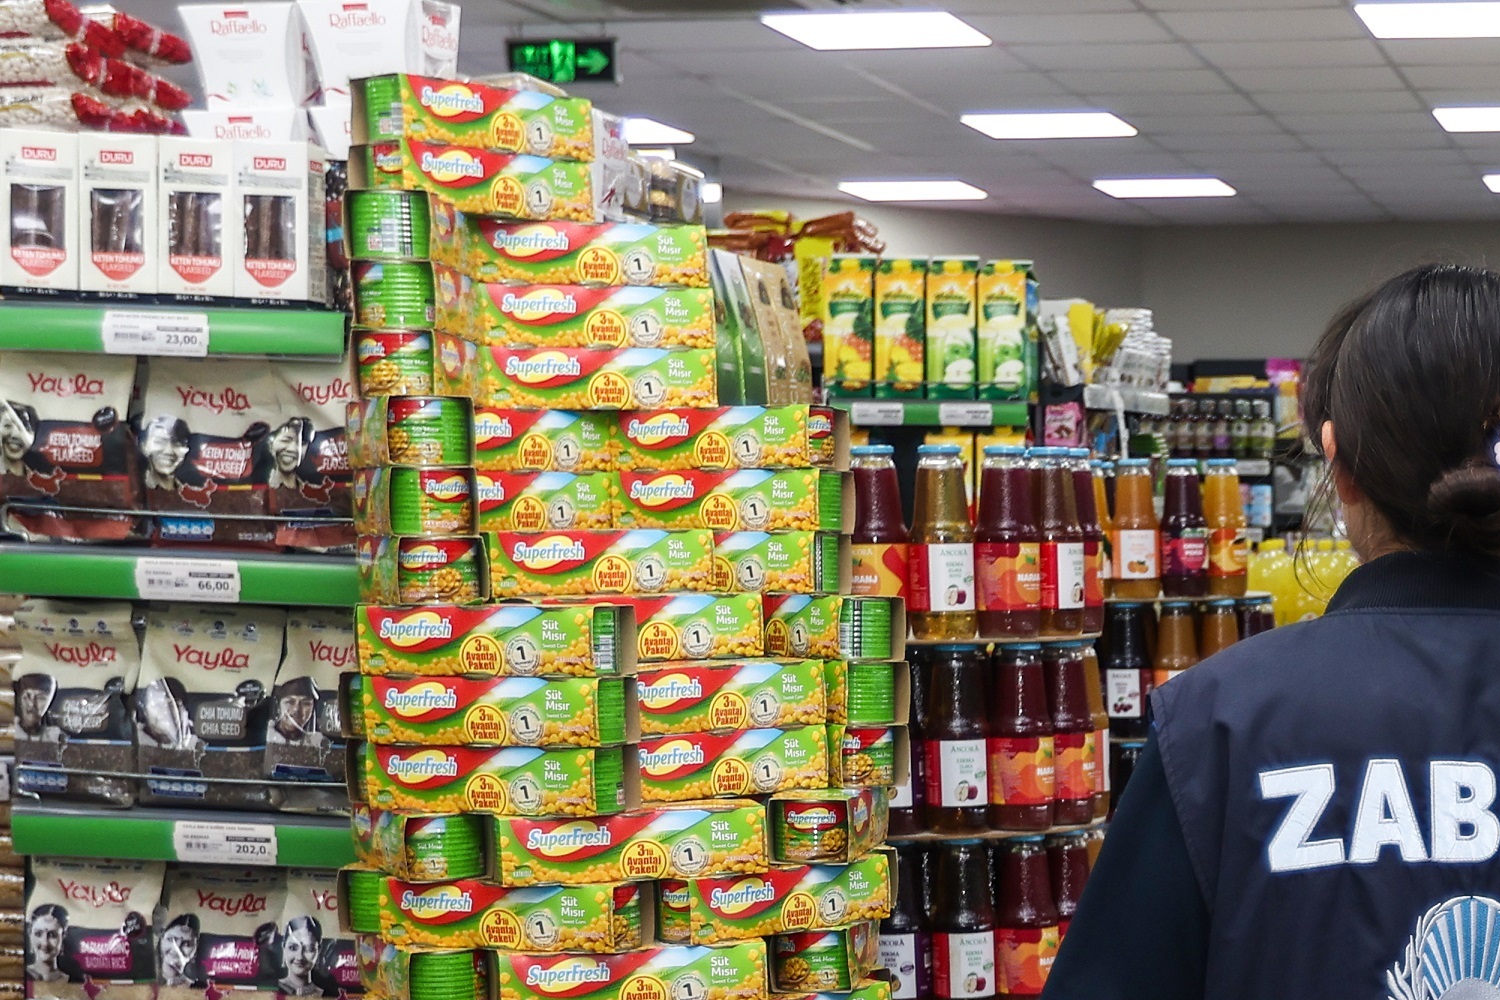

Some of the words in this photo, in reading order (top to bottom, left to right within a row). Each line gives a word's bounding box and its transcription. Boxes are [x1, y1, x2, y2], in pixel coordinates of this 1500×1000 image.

[210, 19, 267, 34] Raffaello
[330, 12, 386, 27] Raffaello
[422, 87, 484, 113] SuperFresh
[215, 118, 271, 138] Raffaello
[23, 150, 55, 159] DURU
[102, 152, 133, 162] DURU
[181, 156, 212, 166] DURU
[255, 159, 286, 169] DURU
[422, 151, 484, 178] SuperFresh
[494, 225, 569, 250] SuperFresh
[658, 234, 674, 246] Süt
[502, 290, 577, 314] SuperFresh
[166, 335, 198, 346] 23,00
[507, 356, 580, 376] SuperFresh
[28, 372, 104, 396] Yayla
[177, 385, 251, 414] Yayla
[628, 419, 690, 437] SuperFresh
[764, 416, 779, 425] Süt
[630, 482, 694, 499] SuperFresh
[513, 542, 585, 561] SuperFresh
[198, 581, 230, 592] 66,00
[380, 619, 452, 638] SuperFresh
[542, 620, 559, 630] Süt
[45, 641, 116, 667] Yayla
[173, 643, 250, 670] Yayla
[466, 651, 497, 662] Avantaj
[468, 660, 495, 670] Paketi
[545, 690, 562, 700] Süt
[637, 677, 702, 700] SuperFresh
[385, 689, 456, 709] SuperFresh
[201, 724, 218, 735] CHIA
[221, 724, 240, 735] SEED
[470, 721, 501, 732] Avantaj
[473, 730, 499, 740] Paketi
[638, 743, 704, 767] SuperFresh
[389, 755, 457, 777] SuperFresh
[711, 821, 729, 831] Süt
[527, 823, 610, 848] SuperFresh
[626, 856, 661, 868] Avantaj
[629, 865, 658, 874] Paketi
[197, 889, 267, 916] Yayla
[401, 891, 472, 912] SuperFresh
[561, 897, 578, 907] Süt
[710, 883, 775, 908] SuperFresh
[527, 959, 610, 984] SuperFresh
